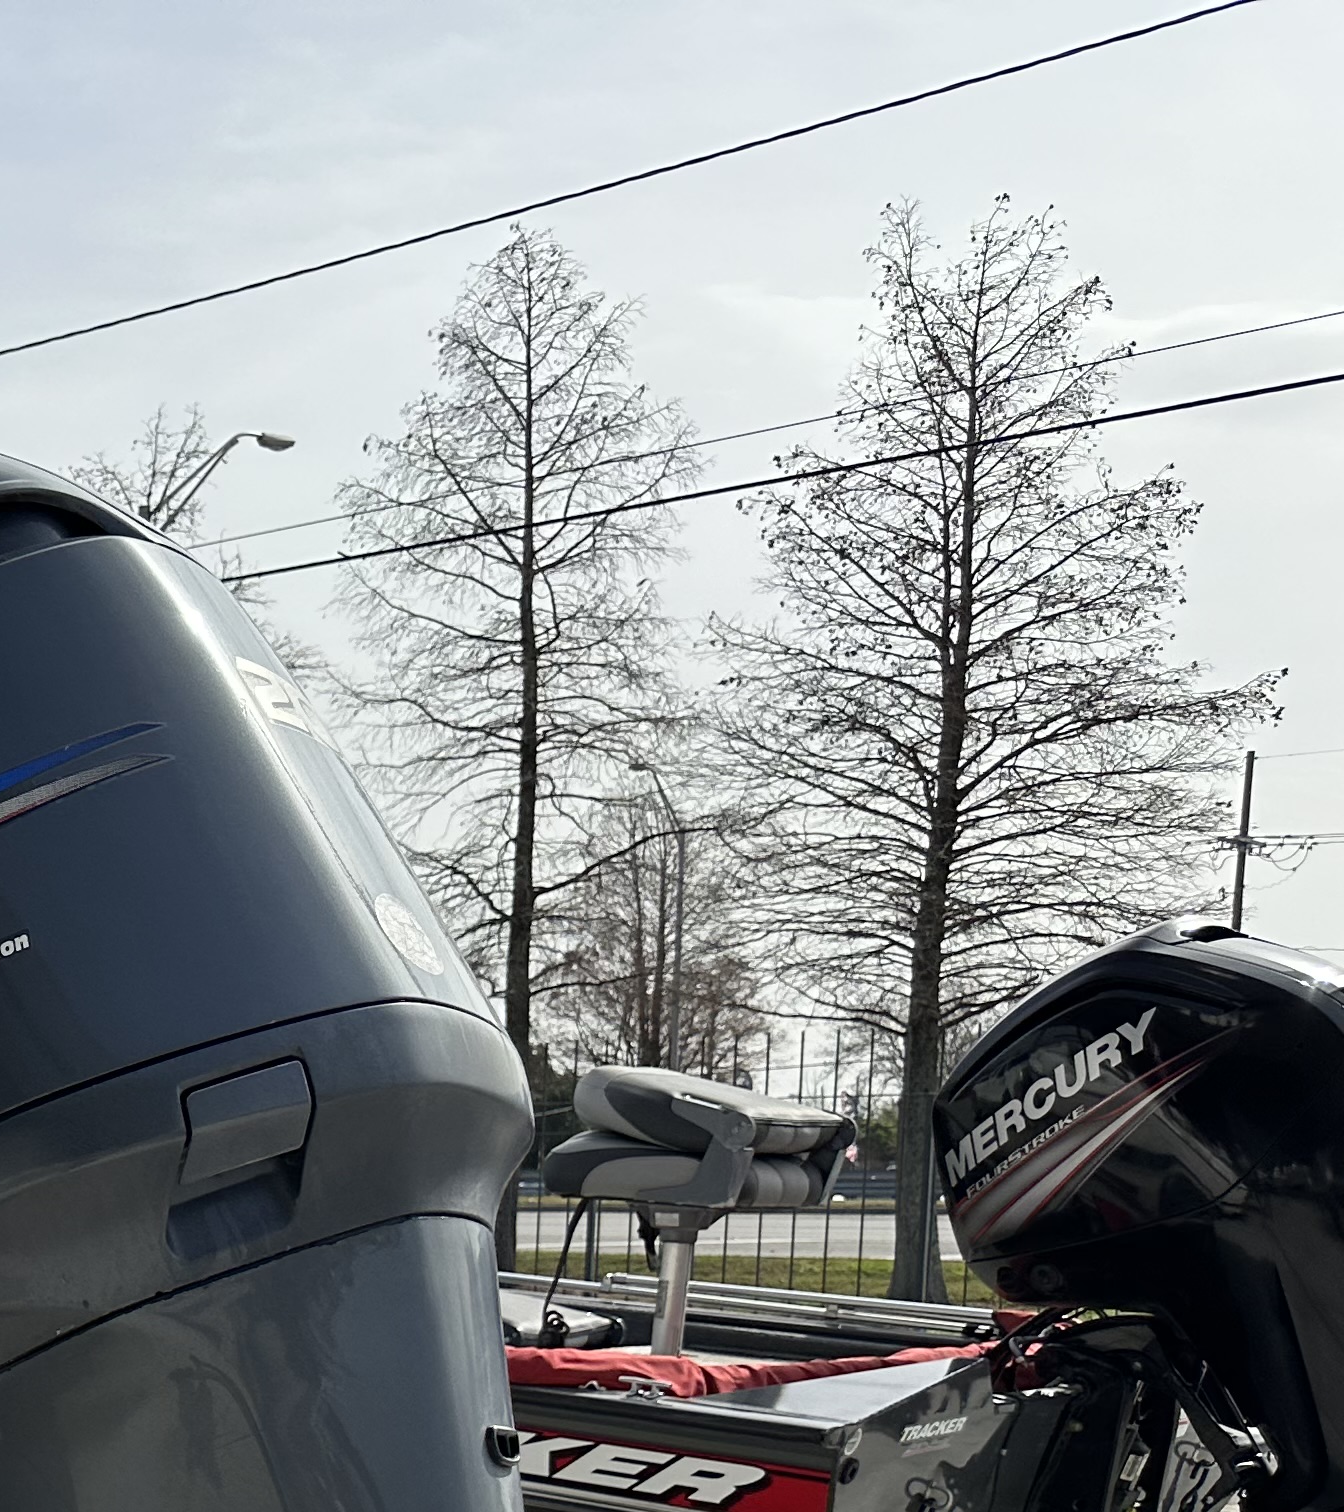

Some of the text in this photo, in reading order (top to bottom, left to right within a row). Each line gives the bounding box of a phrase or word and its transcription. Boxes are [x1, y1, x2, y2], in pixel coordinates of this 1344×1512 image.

[944, 1006, 1156, 1188] MERCURY
[966, 1104, 1086, 1199] FOURSTROKE
[900, 1416, 969, 1443] TRACKER
